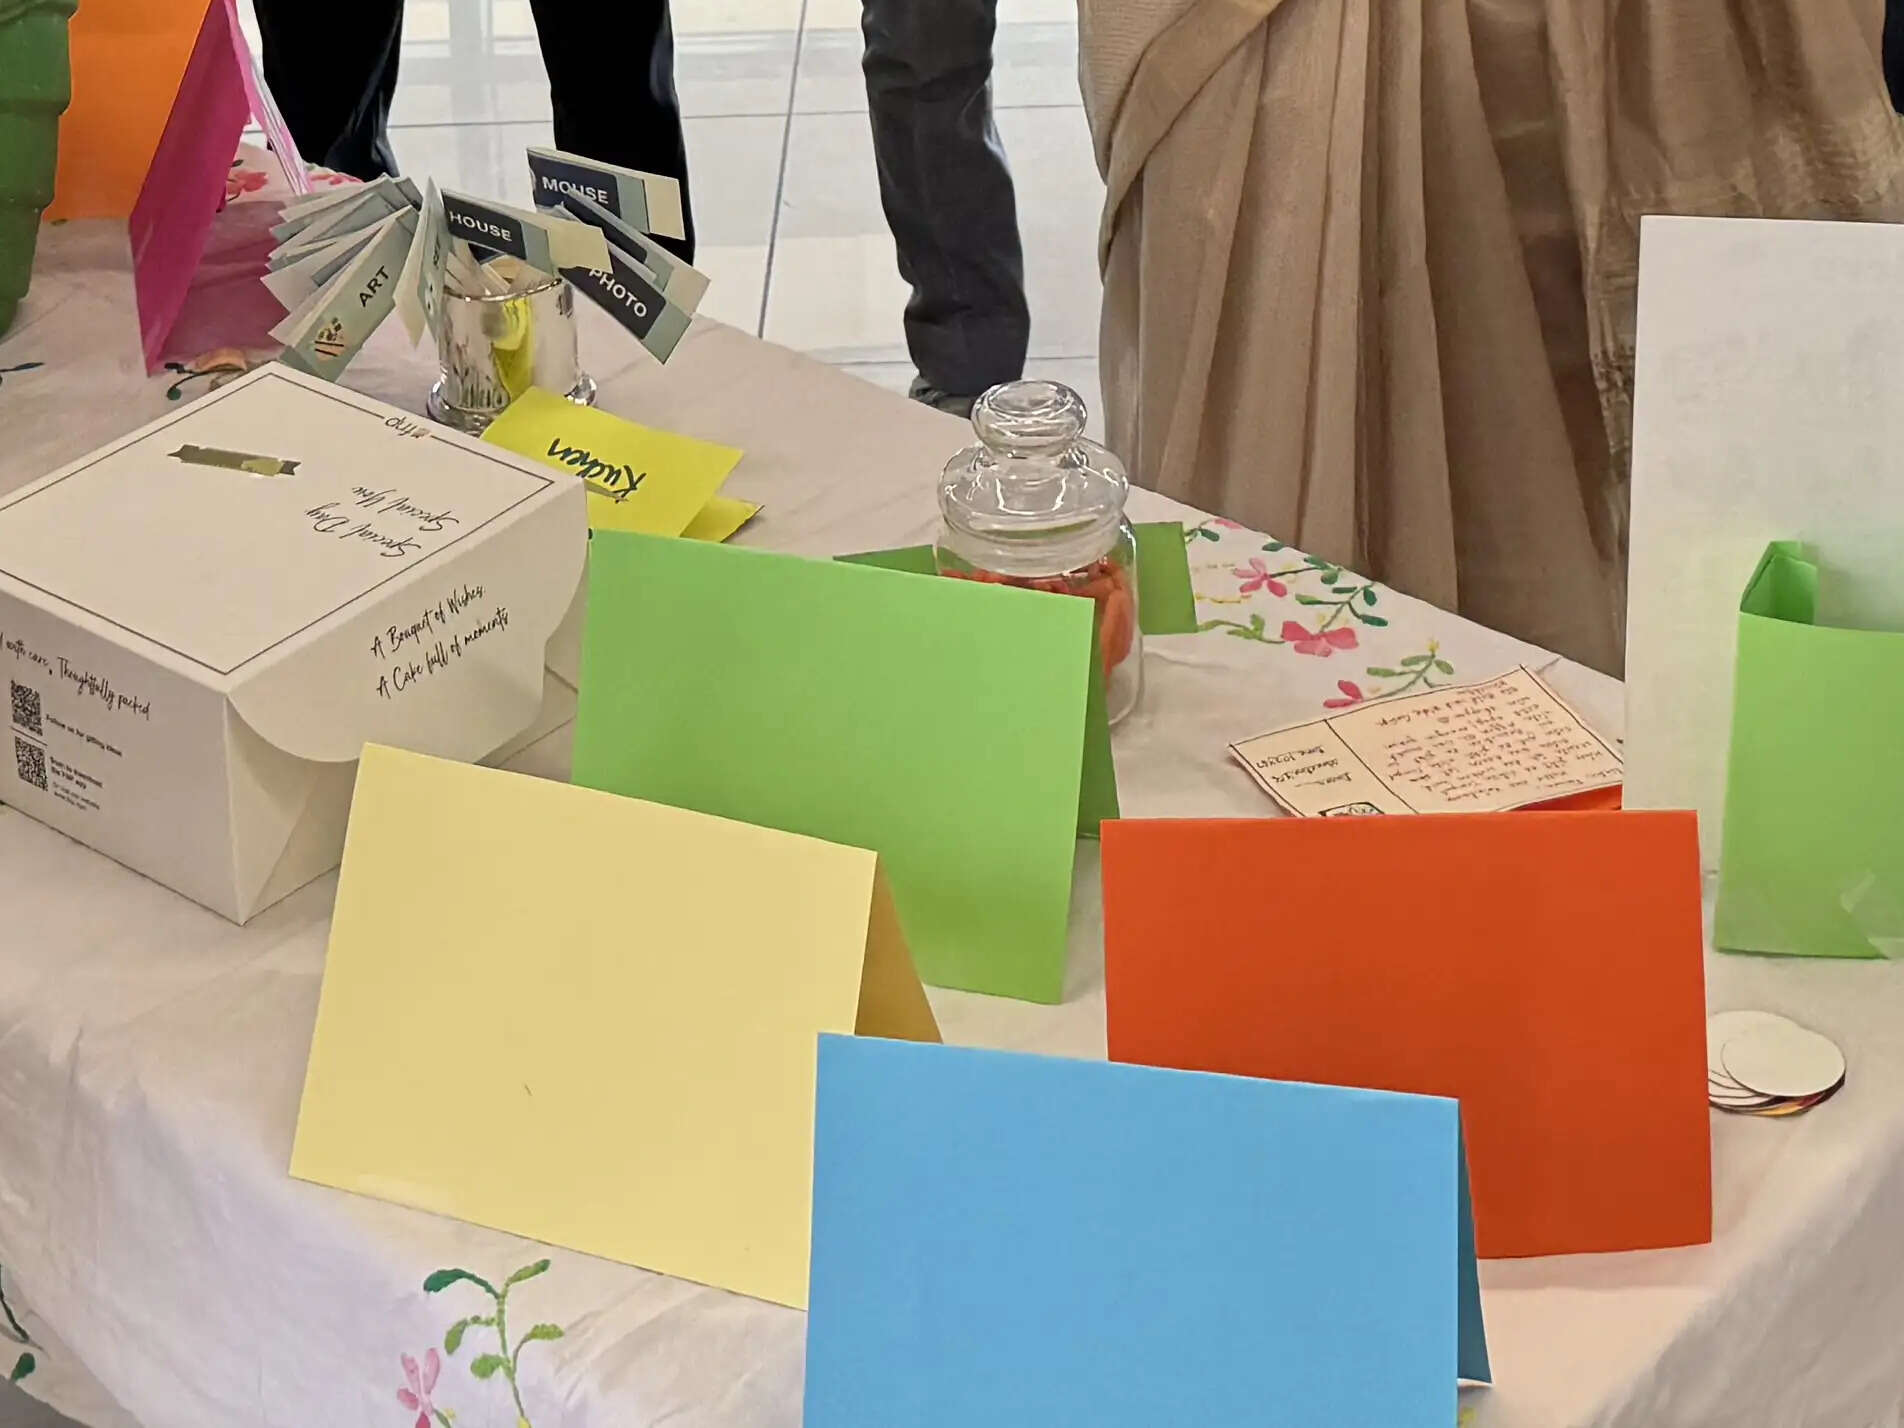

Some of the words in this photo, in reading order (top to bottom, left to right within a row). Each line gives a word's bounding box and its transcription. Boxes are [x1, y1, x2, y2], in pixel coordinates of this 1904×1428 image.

[541, 177, 609, 205] MOUSE
[448, 210, 513, 242] HOUSE
[358, 264, 391, 308] ART
[588, 267, 648, 318] PHOTO
[352, 486, 397, 507] You
[304, 502, 350, 532] Day
[378, 497, 460, 531] Special
[339, 523, 421, 557] Special
[370, 636, 386, 659] A
[434, 601, 446, 624] of
[376, 675, 391, 699] A
[392, 661, 423, 691] Cake
[426, 641, 448, 674] full
[450, 635, 462, 657] of
[464, 607, 509, 646] moments
[6, 640, 26, 660] with
[118, 693, 151, 721] packed
